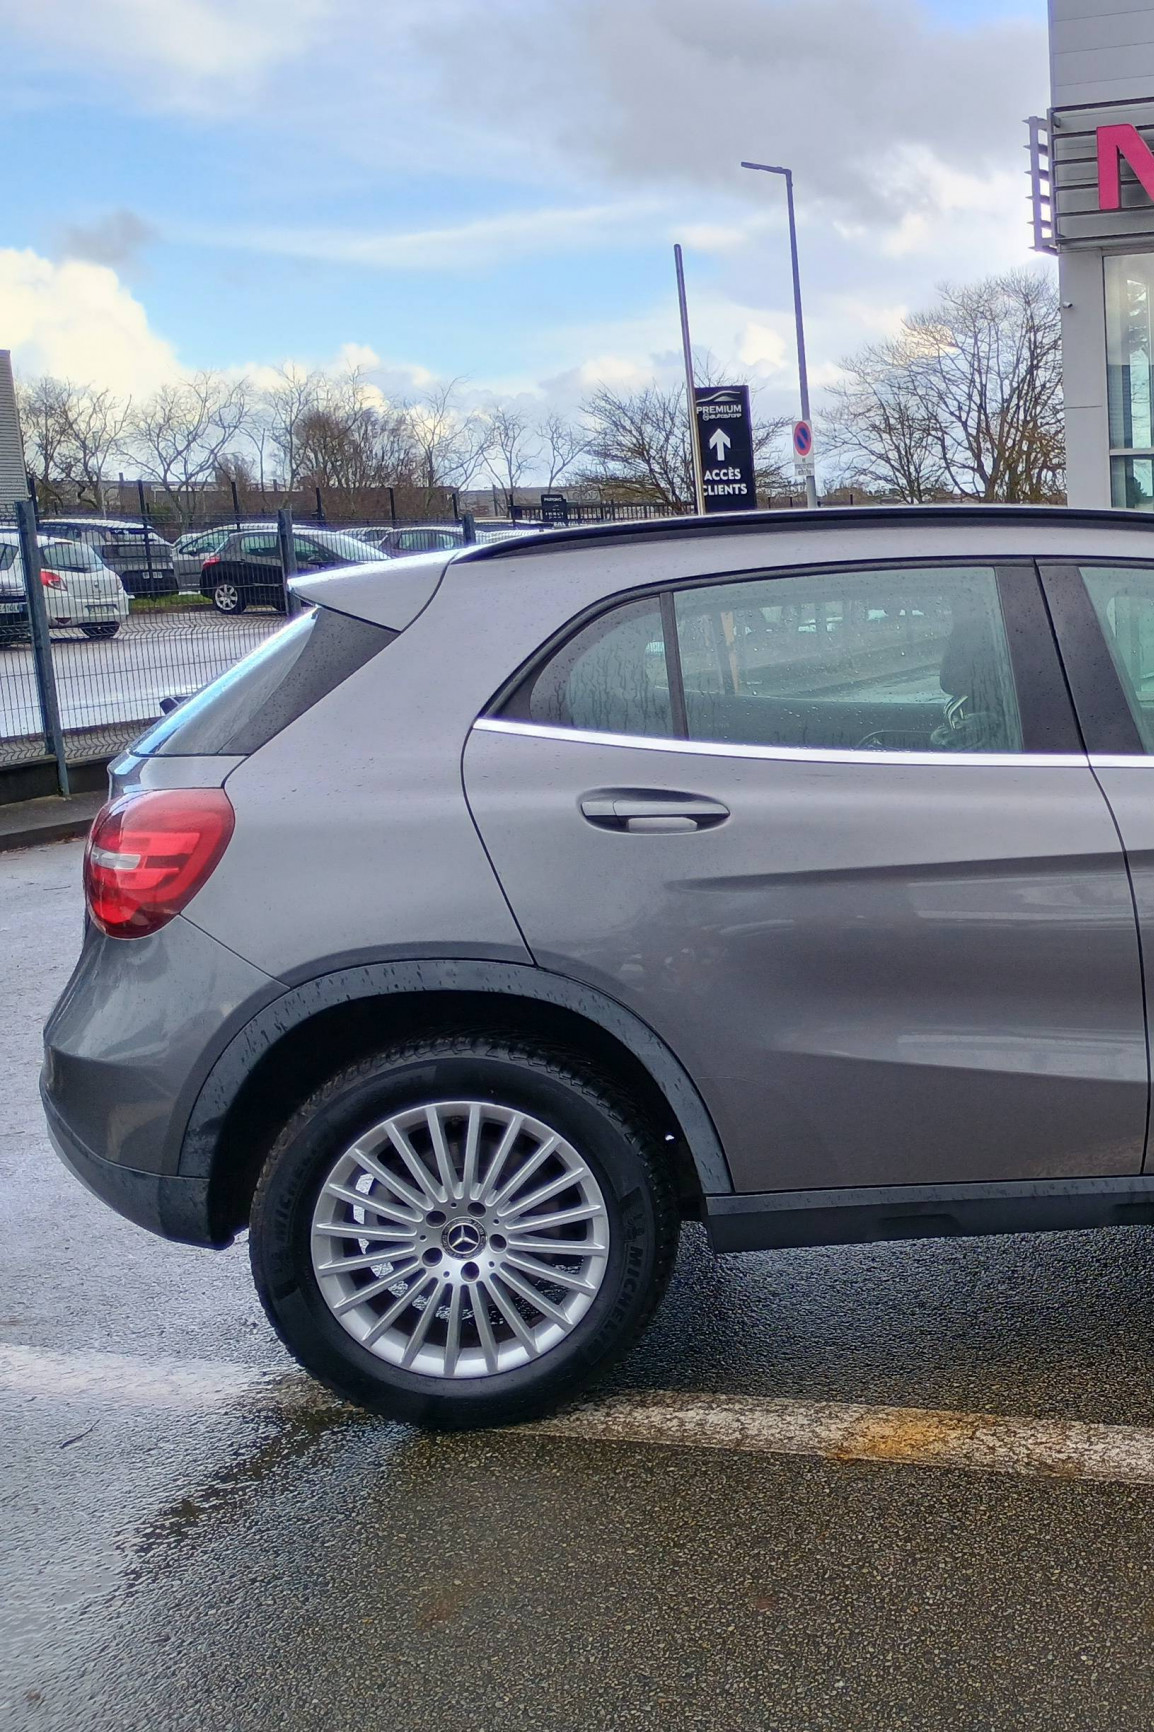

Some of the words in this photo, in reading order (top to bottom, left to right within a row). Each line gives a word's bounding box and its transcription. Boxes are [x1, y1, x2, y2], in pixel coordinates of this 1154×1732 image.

[696, 404, 742, 414] PREMIUM
[704, 467, 741, 480] ACCÈS
[702, 484, 747, 496] CLIENTS
